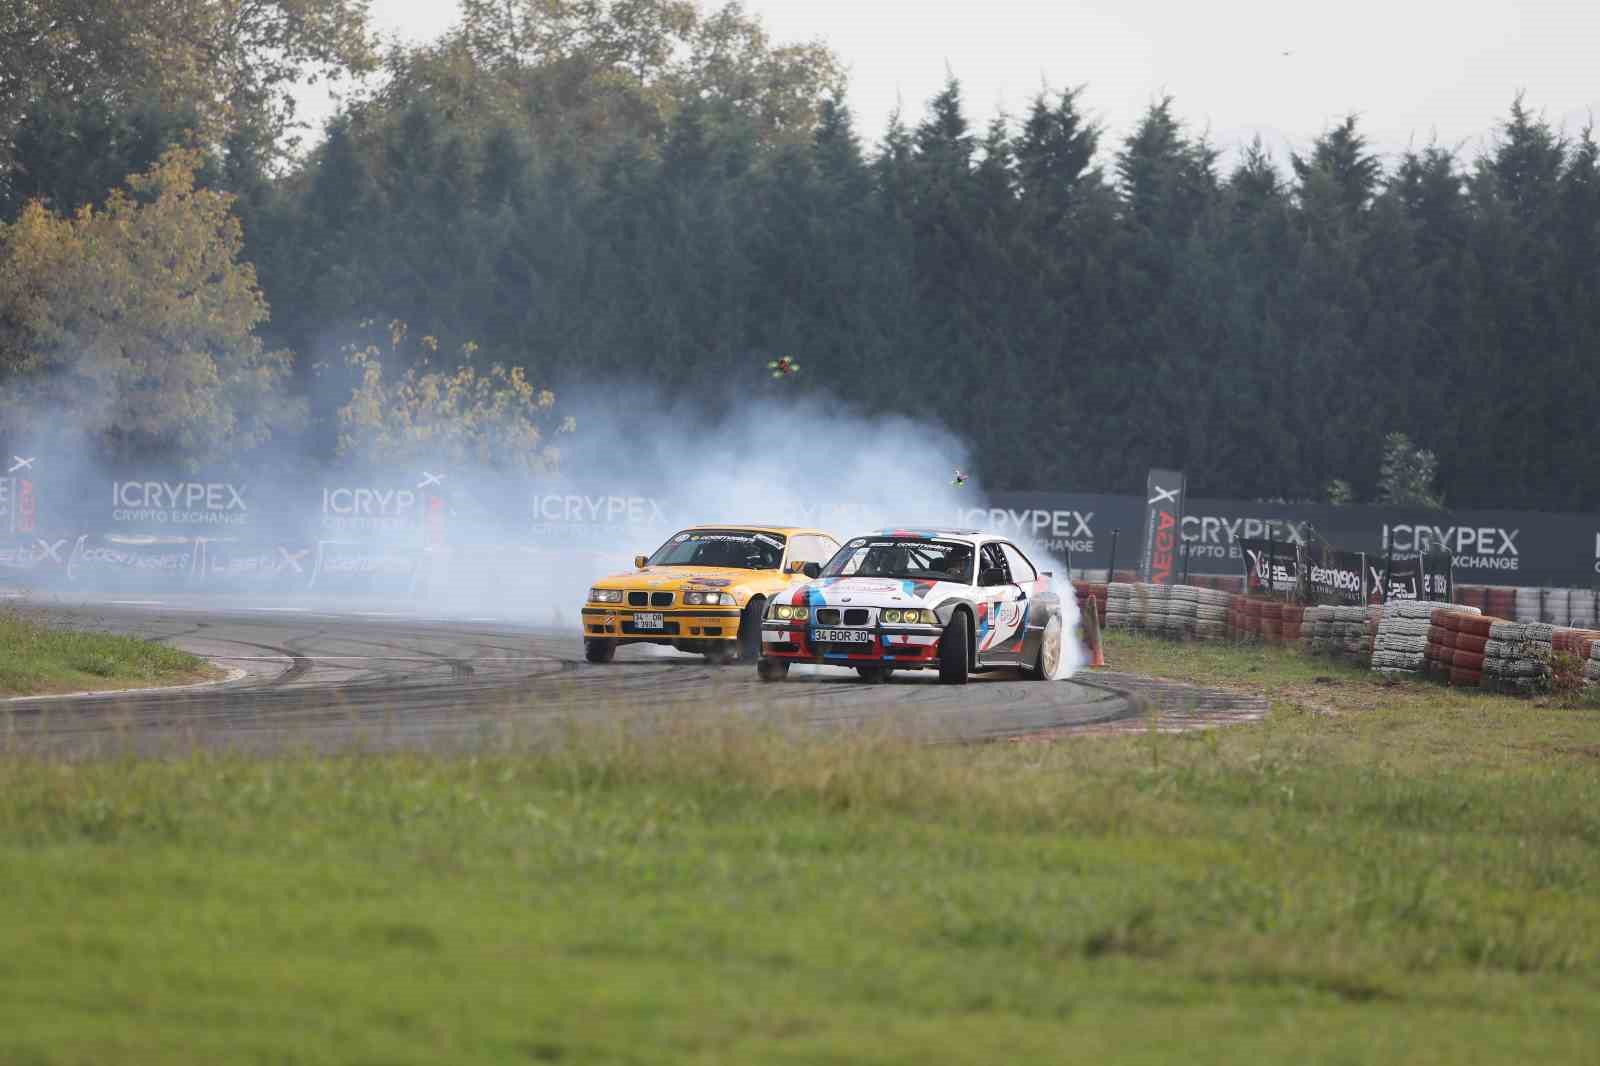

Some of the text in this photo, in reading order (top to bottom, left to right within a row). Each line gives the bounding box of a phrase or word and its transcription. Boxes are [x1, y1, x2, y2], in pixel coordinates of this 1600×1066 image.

[112, 481, 248, 510] ICRYPEX
[322, 488, 416, 515] ICRYP
[112, 510, 249, 525] CRYPTO EXCHANGE
[532, 495, 668, 522] ICRYPEX
[1451, 555, 1520, 571] XCHANGE
[815, 630, 868, 643] 34 BOR 30
